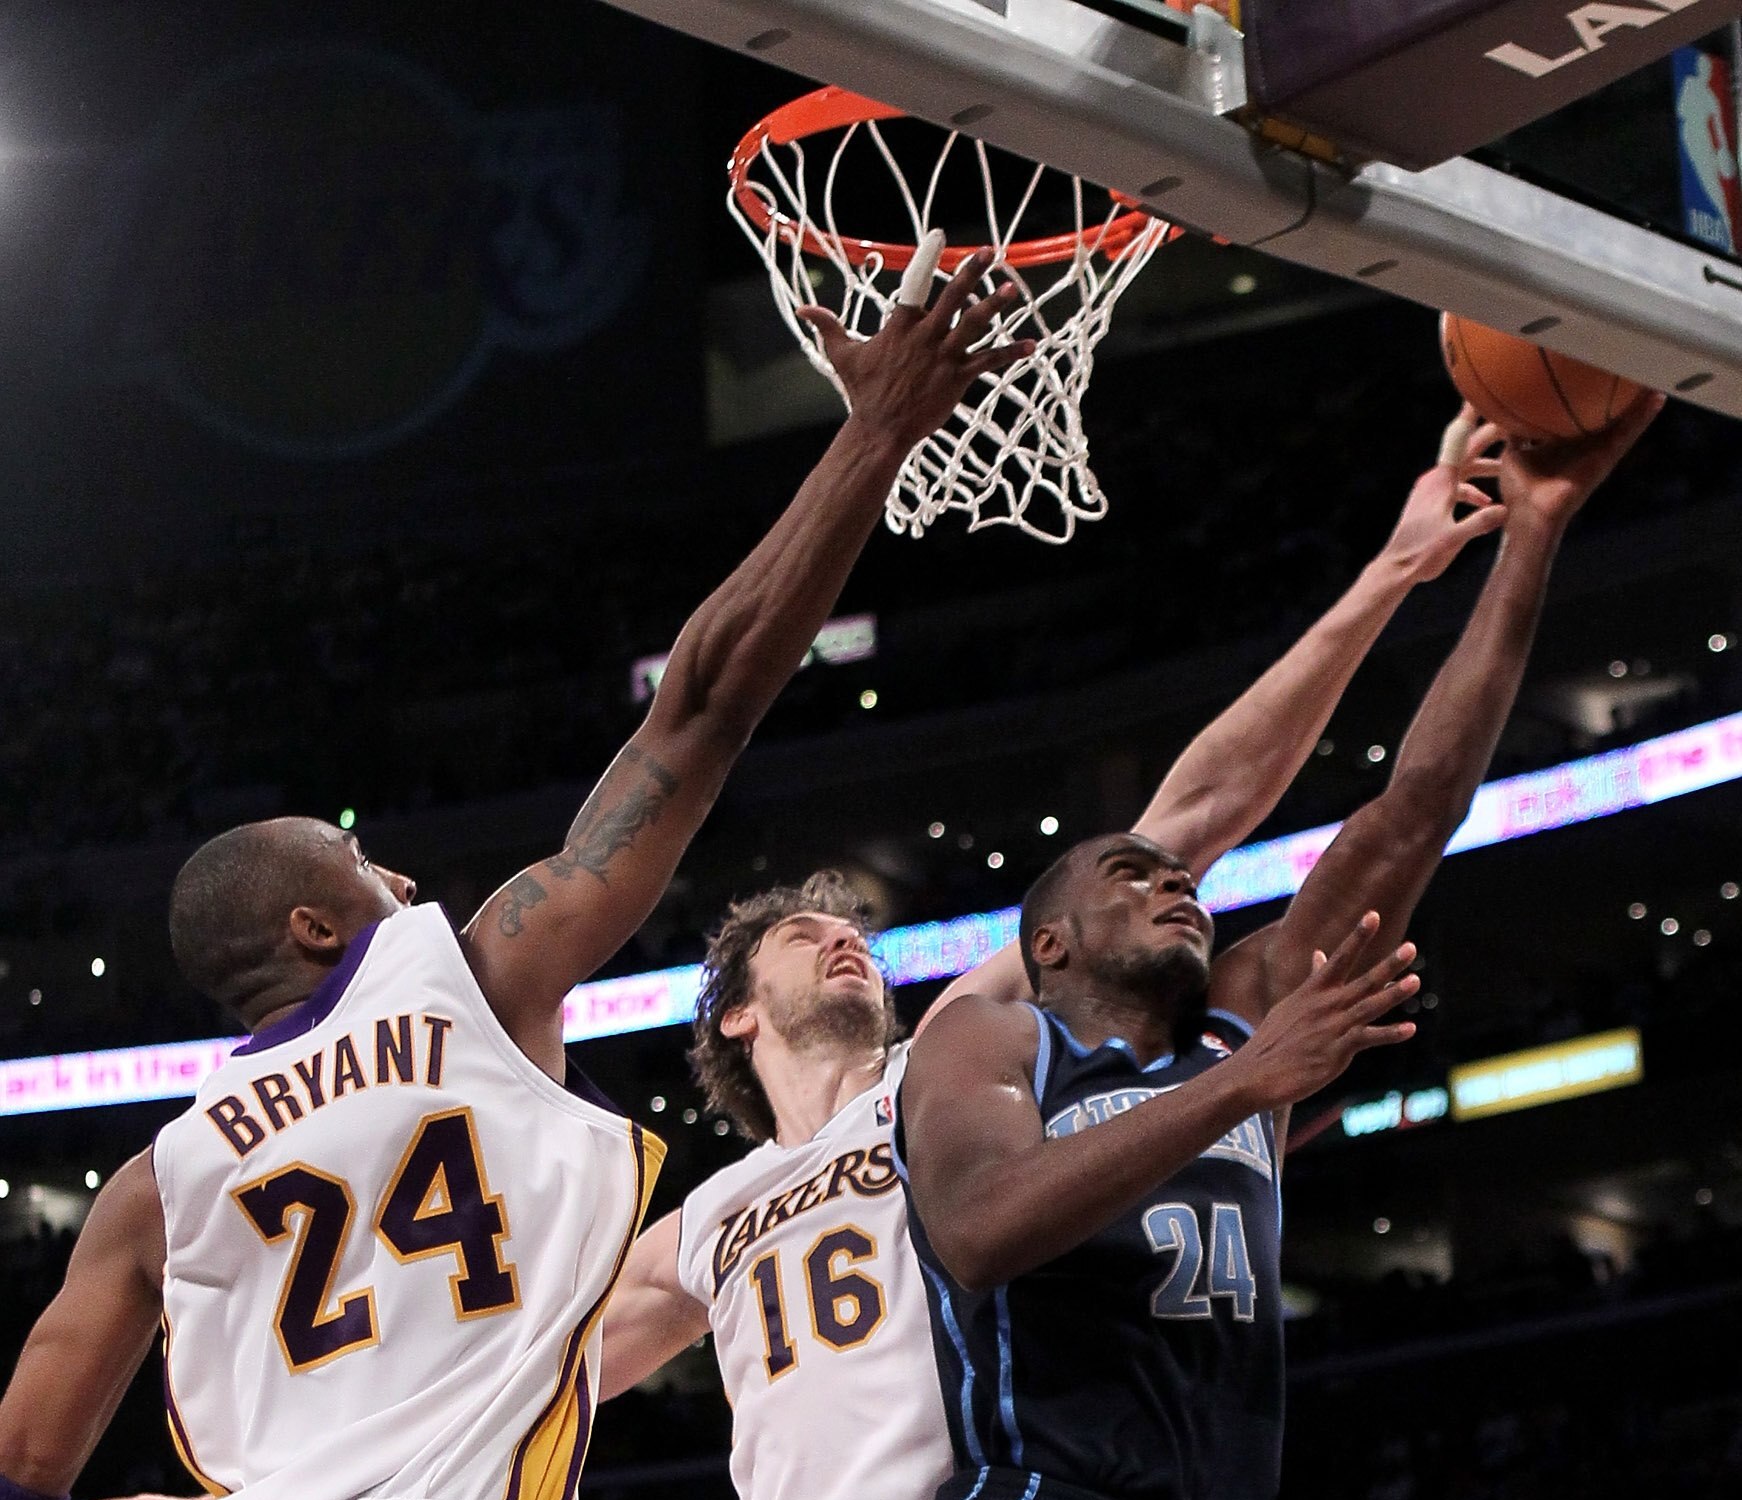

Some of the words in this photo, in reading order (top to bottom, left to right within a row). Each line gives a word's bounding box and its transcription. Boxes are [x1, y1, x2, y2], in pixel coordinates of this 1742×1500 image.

[205, 1013, 453, 1160] BRYANT
[229, 1106, 522, 1377] 24
[713, 1142, 902, 1304] LAKERS
[1142, 1202, 1258, 1323] 24
[750, 1223, 888, 1386] 16
